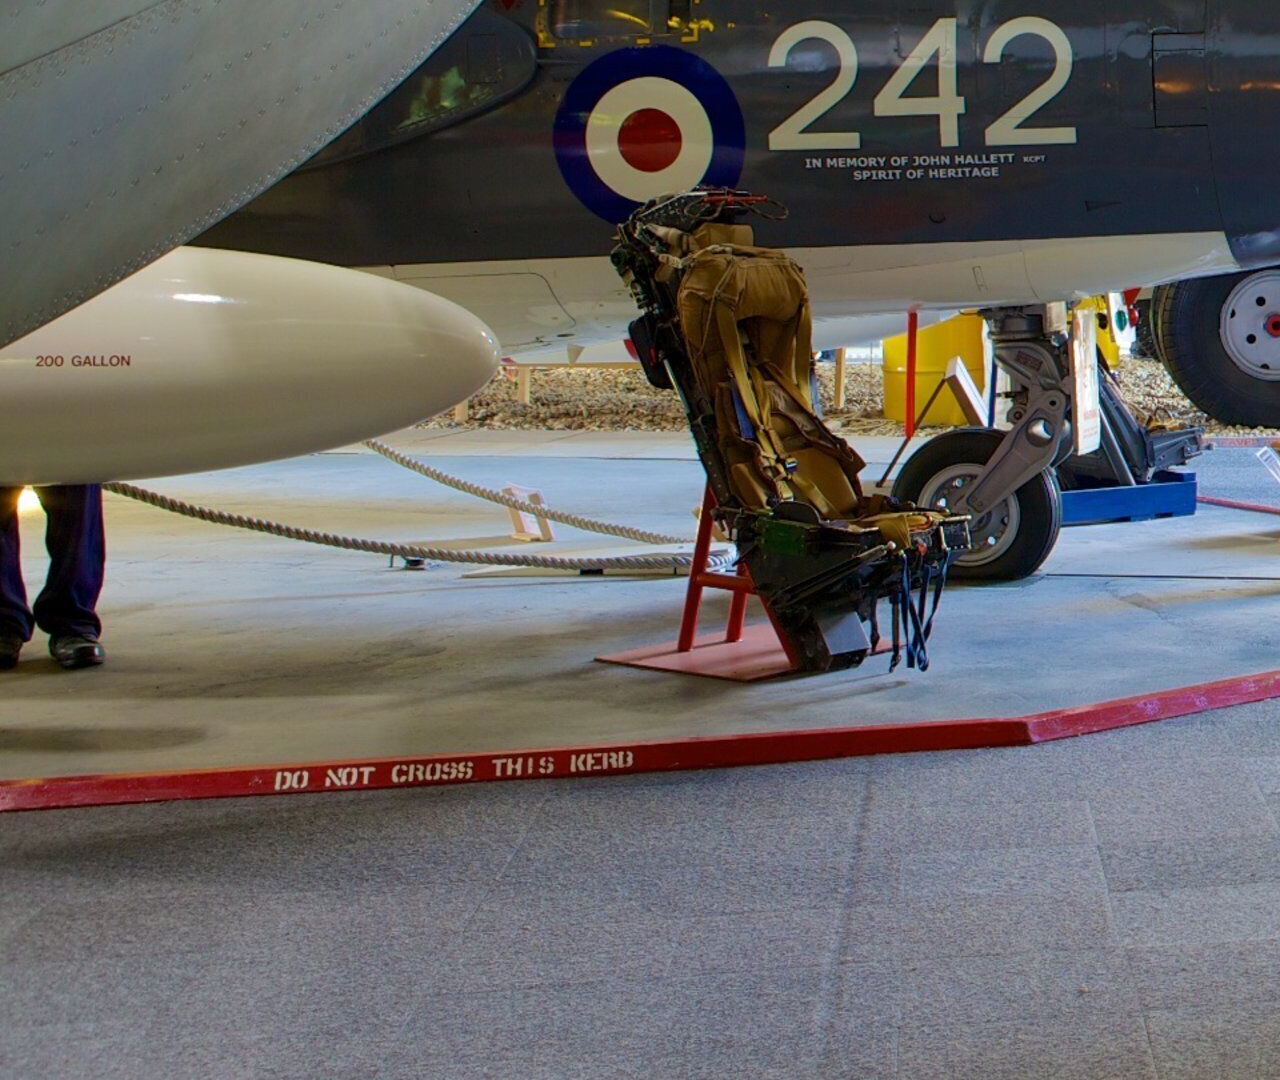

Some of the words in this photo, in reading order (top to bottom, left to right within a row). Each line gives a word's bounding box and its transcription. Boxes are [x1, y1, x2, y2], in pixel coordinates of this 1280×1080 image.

[768, 15, 1078, 151] 242
[805, 157, 822, 169] IN
[826, 156, 886, 169] MEMORY
[890, 155, 909, 168] OF
[913, 155, 952, 167] JOHN
[955, 153, 1016, 166] HALLETT
[853, 169, 902, 181] SPIRIT
[906, 168, 925, 180] OF
[929, 166, 1001, 179] HERITAGE
[35, 355, 64, 367] 200
[71, 355, 131, 367] GALLON
[274, 770, 309, 792] DO
[325, 766, 377, 788] NOT
[391, 761, 474, 783] CROSS
[492, 756, 555, 777] THIS
[570, 751, 634, 773] KERB
